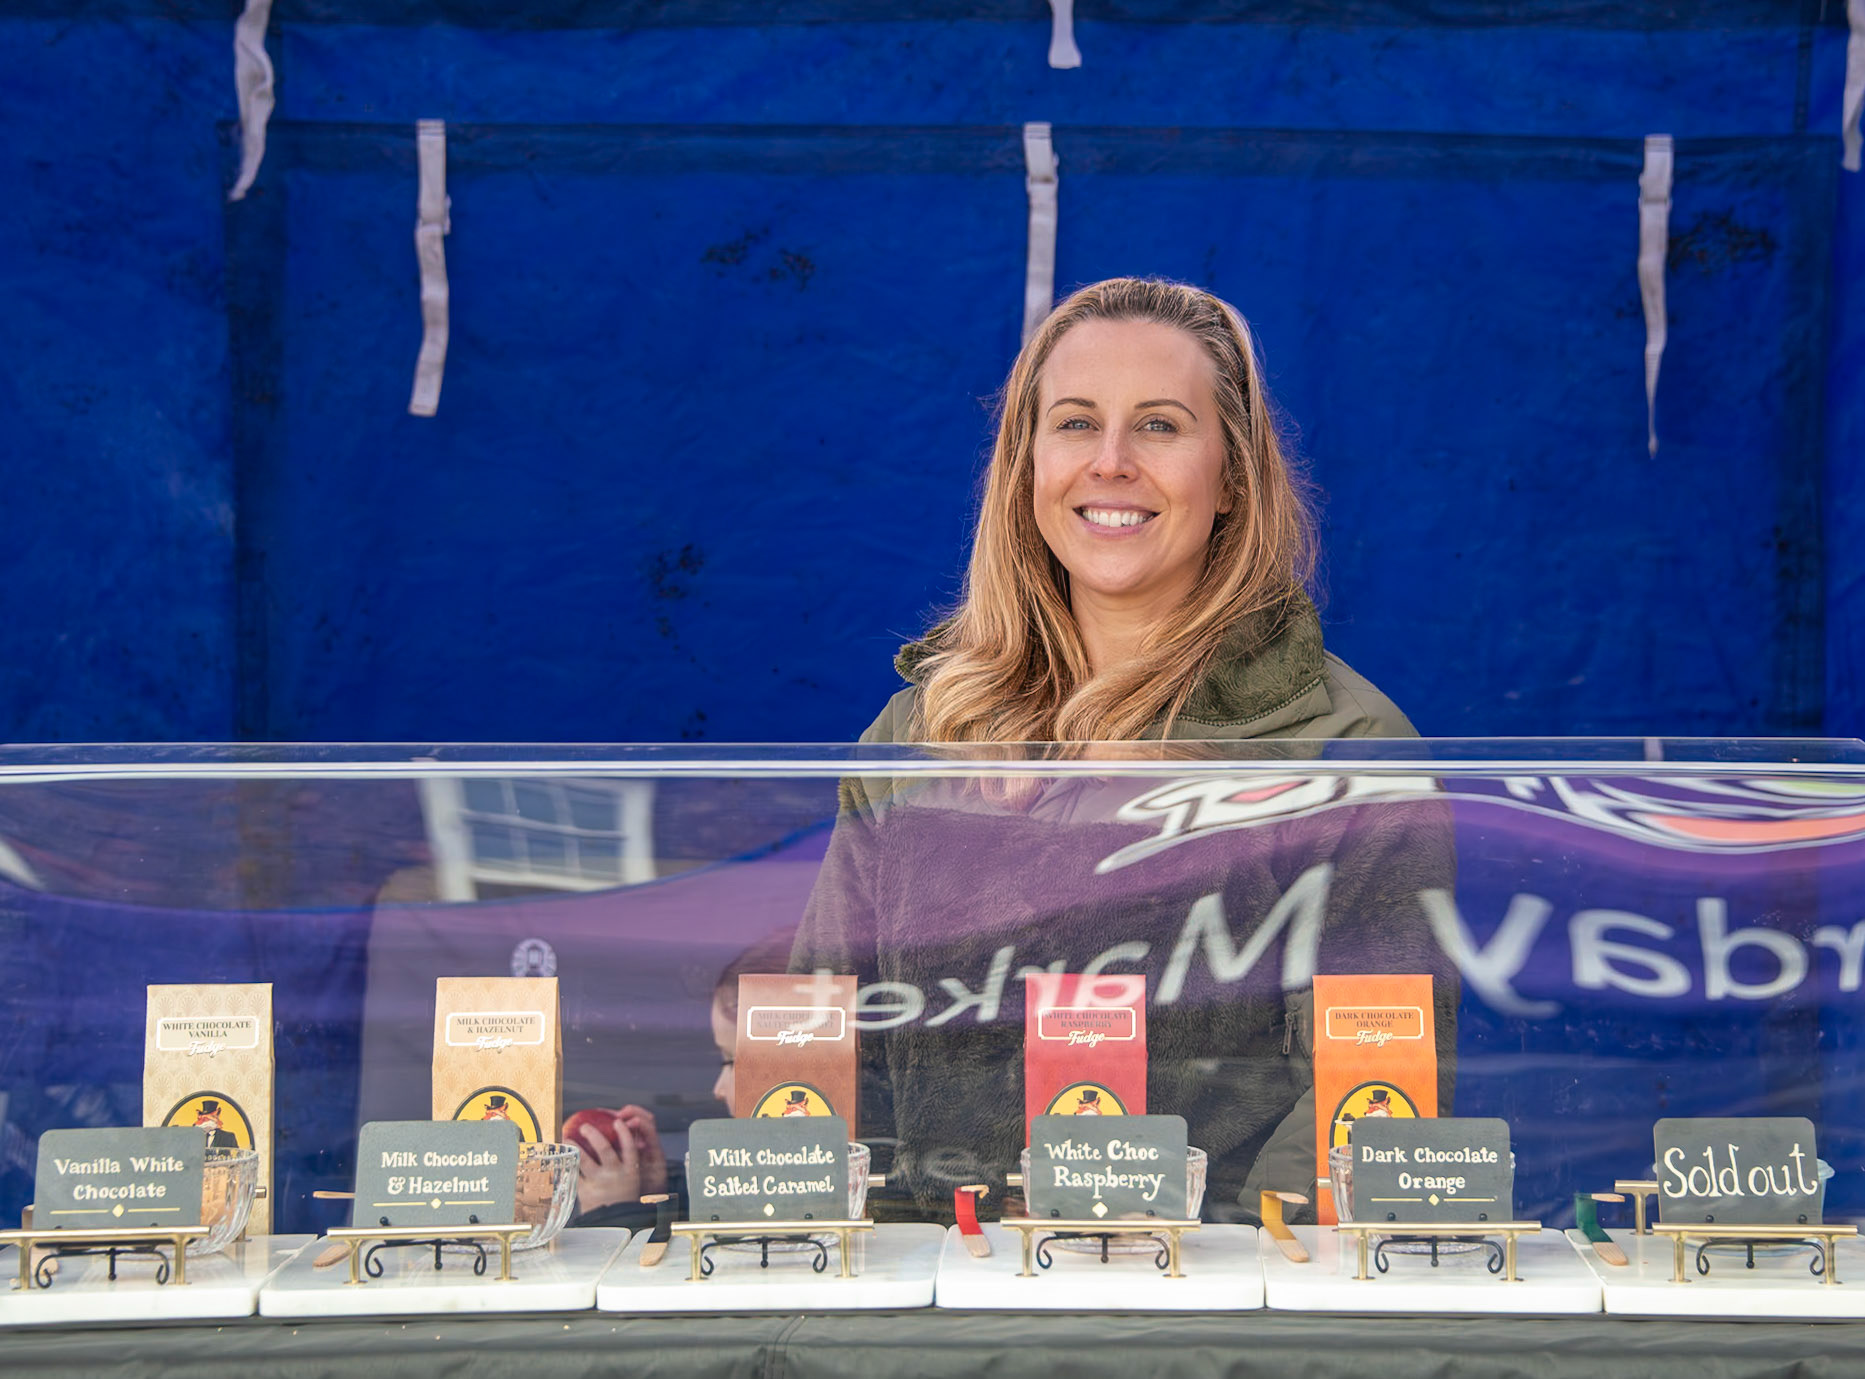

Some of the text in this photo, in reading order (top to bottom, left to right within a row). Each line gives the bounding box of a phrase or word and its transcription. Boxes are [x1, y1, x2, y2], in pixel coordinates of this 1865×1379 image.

[163, 1021, 251, 1030] WHITE CHOCOLATE
[467, 1025, 524, 1034] & HAZELNUT
[482, 1017, 535, 1025] CHOCOLATE
[1061, 1020, 1111, 1028] RASPBERRY
[189, 1030, 228, 1038] VANILLA
[776, 1030, 814, 1047] Fudge
[1068, 1030, 1105, 1048] Fudge
[1356, 1029, 1393, 1047] Fudge
[187, 1040, 226, 1058] Fudge
[475, 1035, 513, 1053] Fudge
[381, 1150, 498, 1168] Milk Chocolate
[708, 1144, 835, 1167] Milk Chocolate
[1044, 1139, 1159, 1161] White Choc
[1361, 1146, 1498, 1163] Dark Chocolate
[54, 1156, 184, 1175] Vanilla White
[1663, 1142, 1818, 1198] Sold out
[73, 1183, 167, 1200] Chocolate
[387, 1176, 489, 1195] & Hazelnut
[703, 1175, 835, 1197] Salted Caramel
[1053, 1165, 1165, 1201] Raspberry
[1398, 1173, 1466, 1194] Orange
